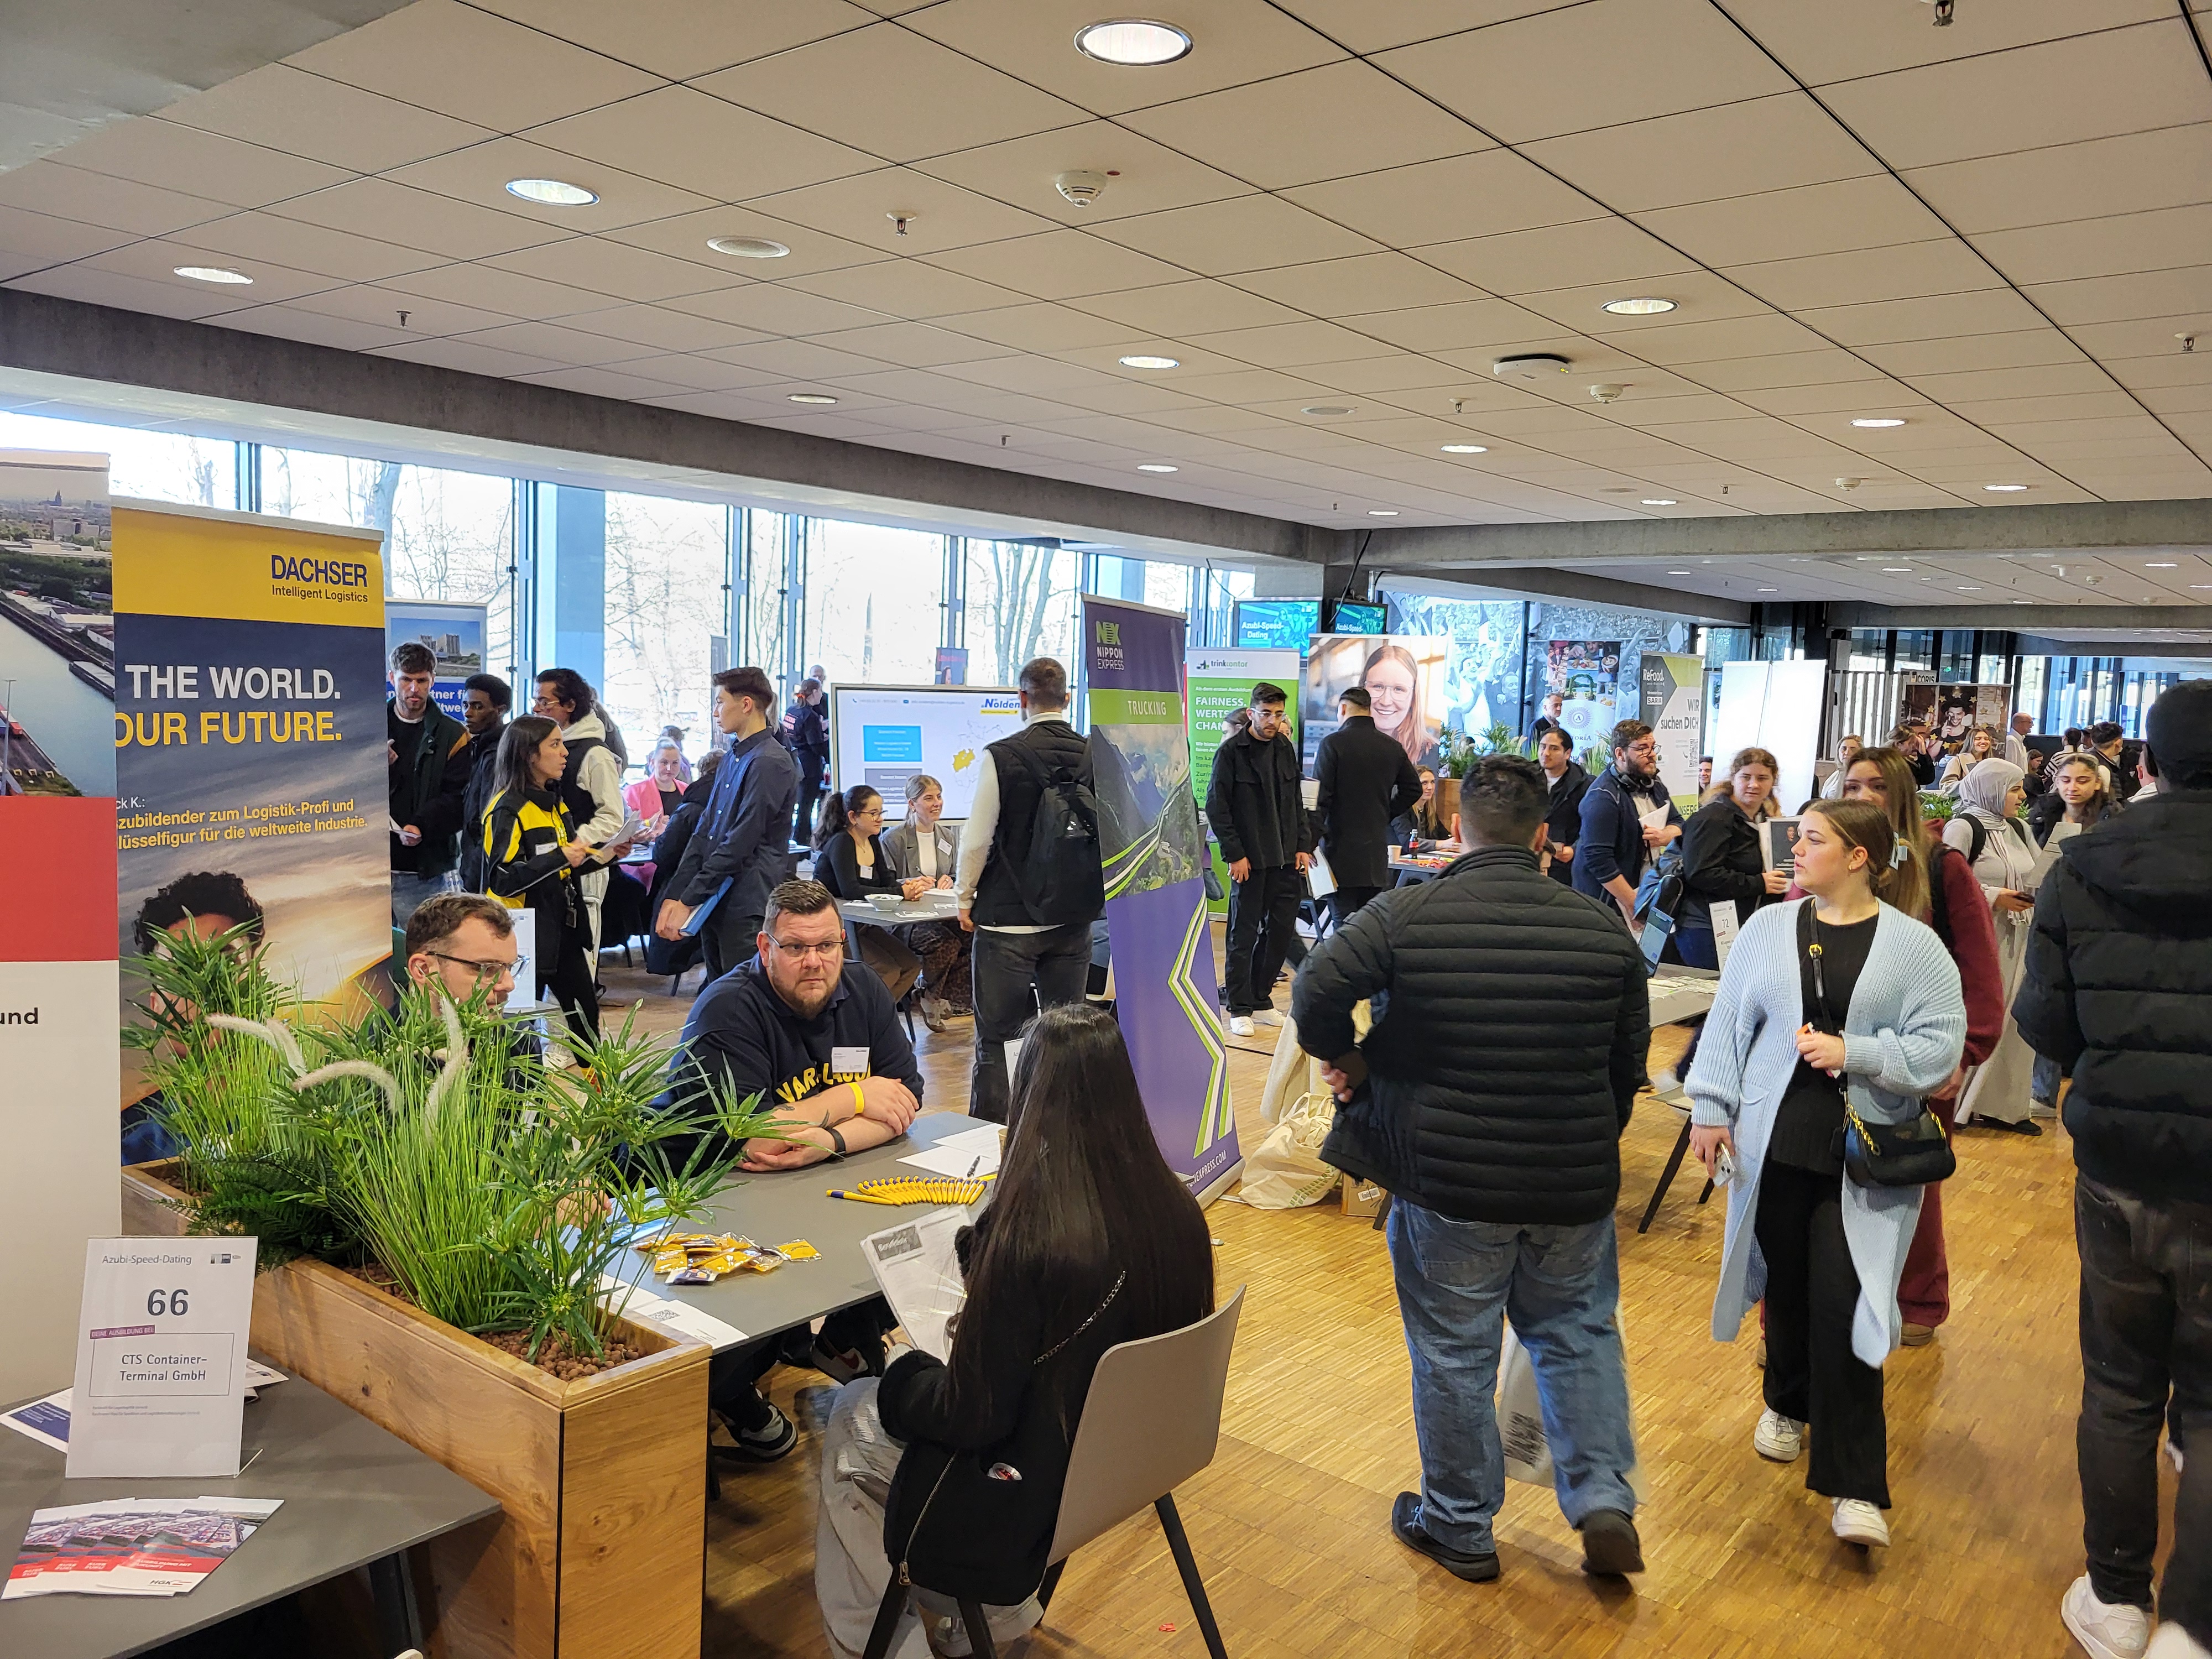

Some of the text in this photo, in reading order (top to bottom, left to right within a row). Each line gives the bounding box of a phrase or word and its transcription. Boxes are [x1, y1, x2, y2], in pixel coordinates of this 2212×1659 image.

[272, 555, 368, 587] DACHSER
[272, 584, 368, 603] Intelligent Logistics
[1241, 622, 1284, 630] Azubi-Speed-
[1247, 631, 1269, 639] Dating
[1097, 646, 1123, 660] NIPPON
[1097, 659, 1124, 670] EXPRESS
[1643, 669, 1664, 681] ReFood
[125, 665, 341, 700] THE WORLD.
[985, 698, 1020, 708] Nolden
[1128, 701, 1166, 715] TRUCKING
[1196, 697, 1246, 706] FAIRNESS.
[1687, 699, 1699, 712] WIR
[200, 711, 342, 744] FUTURE.
[1661, 716, 1699, 729] suchen DICH
[131, 796, 145, 808] K.:
[117, 798, 354, 830] zubildender zum Logistik-Profi und
[118, 815, 368, 850] lüsselfigur für die weltweite Industrie.
[102, 1255, 192, 1265] Azubi-Speed-Dating
[148, 1289, 189, 1316] 66
[122, 1354, 207, 1365] CTS Container-
[120, 1370, 206, 1381] Terminal GmbH
